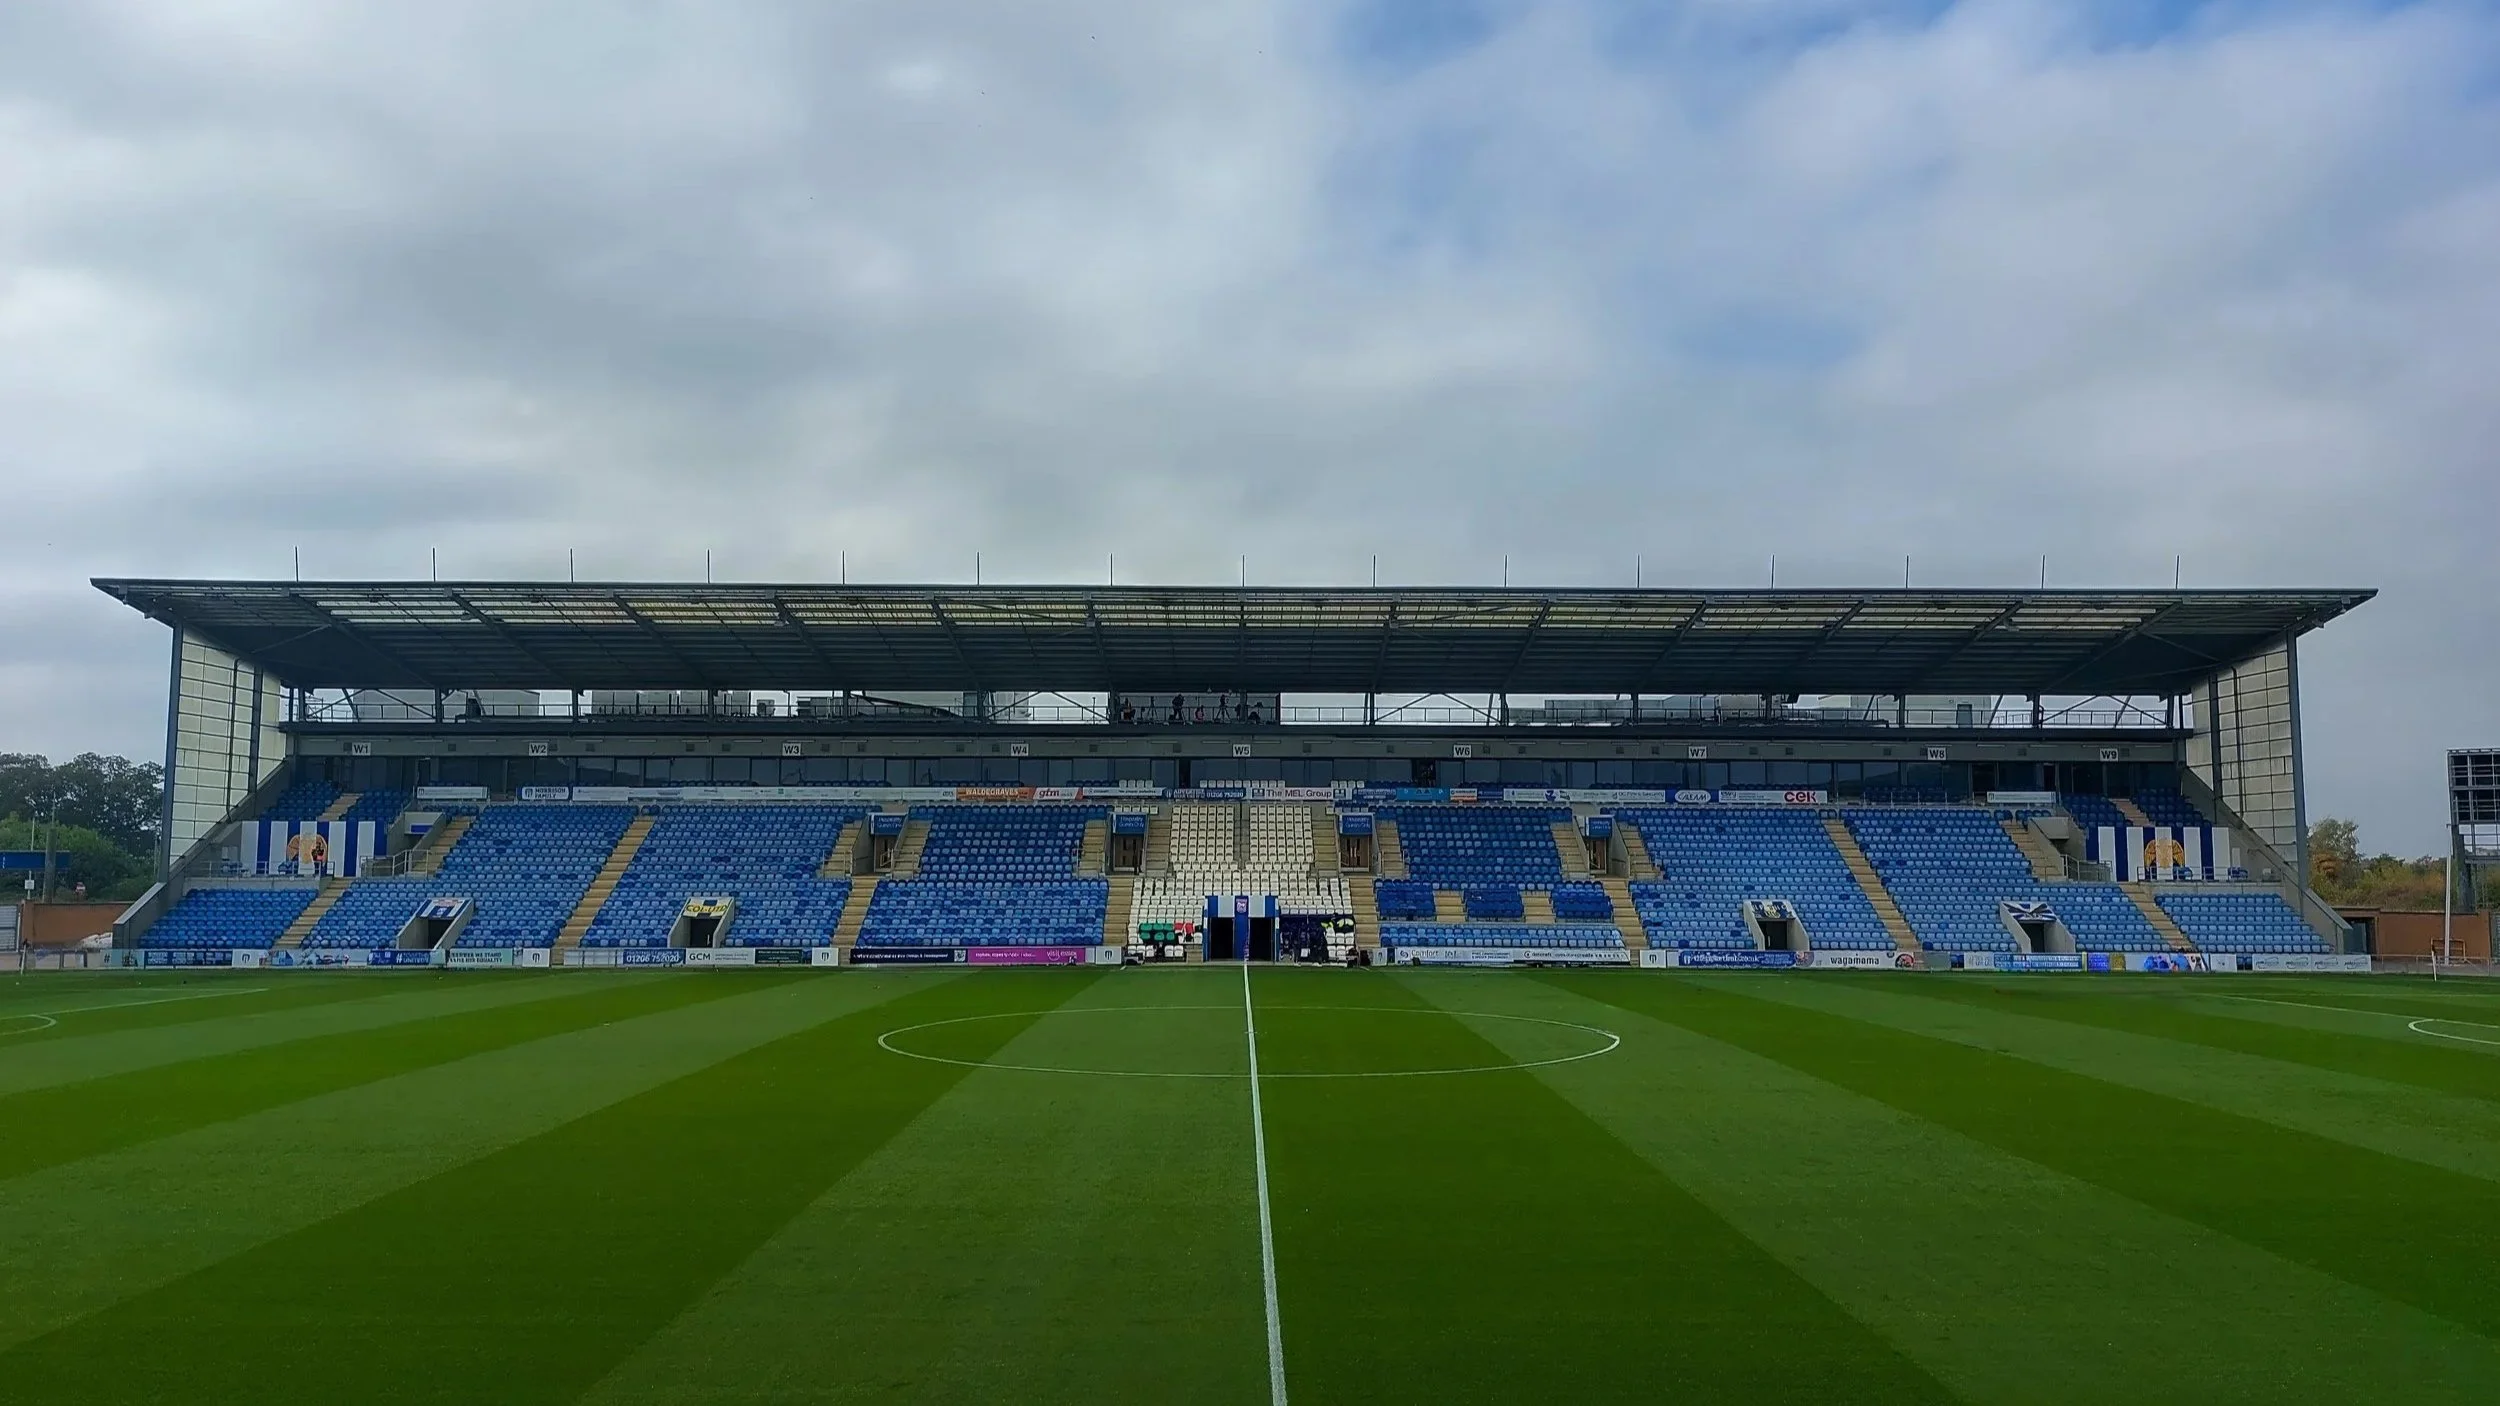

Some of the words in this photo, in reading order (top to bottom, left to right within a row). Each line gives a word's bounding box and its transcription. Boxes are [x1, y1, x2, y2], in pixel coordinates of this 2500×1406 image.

[354, 745, 369, 753] W1
[530, 745, 547, 754] W2
[784, 746, 800, 755] W3
[1012, 746, 1028, 755] W4
[1234, 746, 1250, 755] W5
[1455, 747, 1471, 756] W6
[1690, 748, 1706, 757] W7
[1929, 749, 1945, 758] W8
[2101, 750, 2118, 759] W9
[1266, 789, 1283, 798] The
[1285, 789, 1304, 798] MEL
[1306, 789, 1333, 800] Group
[626, 955, 650, 963] 01206
[689, 953, 711, 962] GCM
[1830, 956, 1880, 966] wagamama
